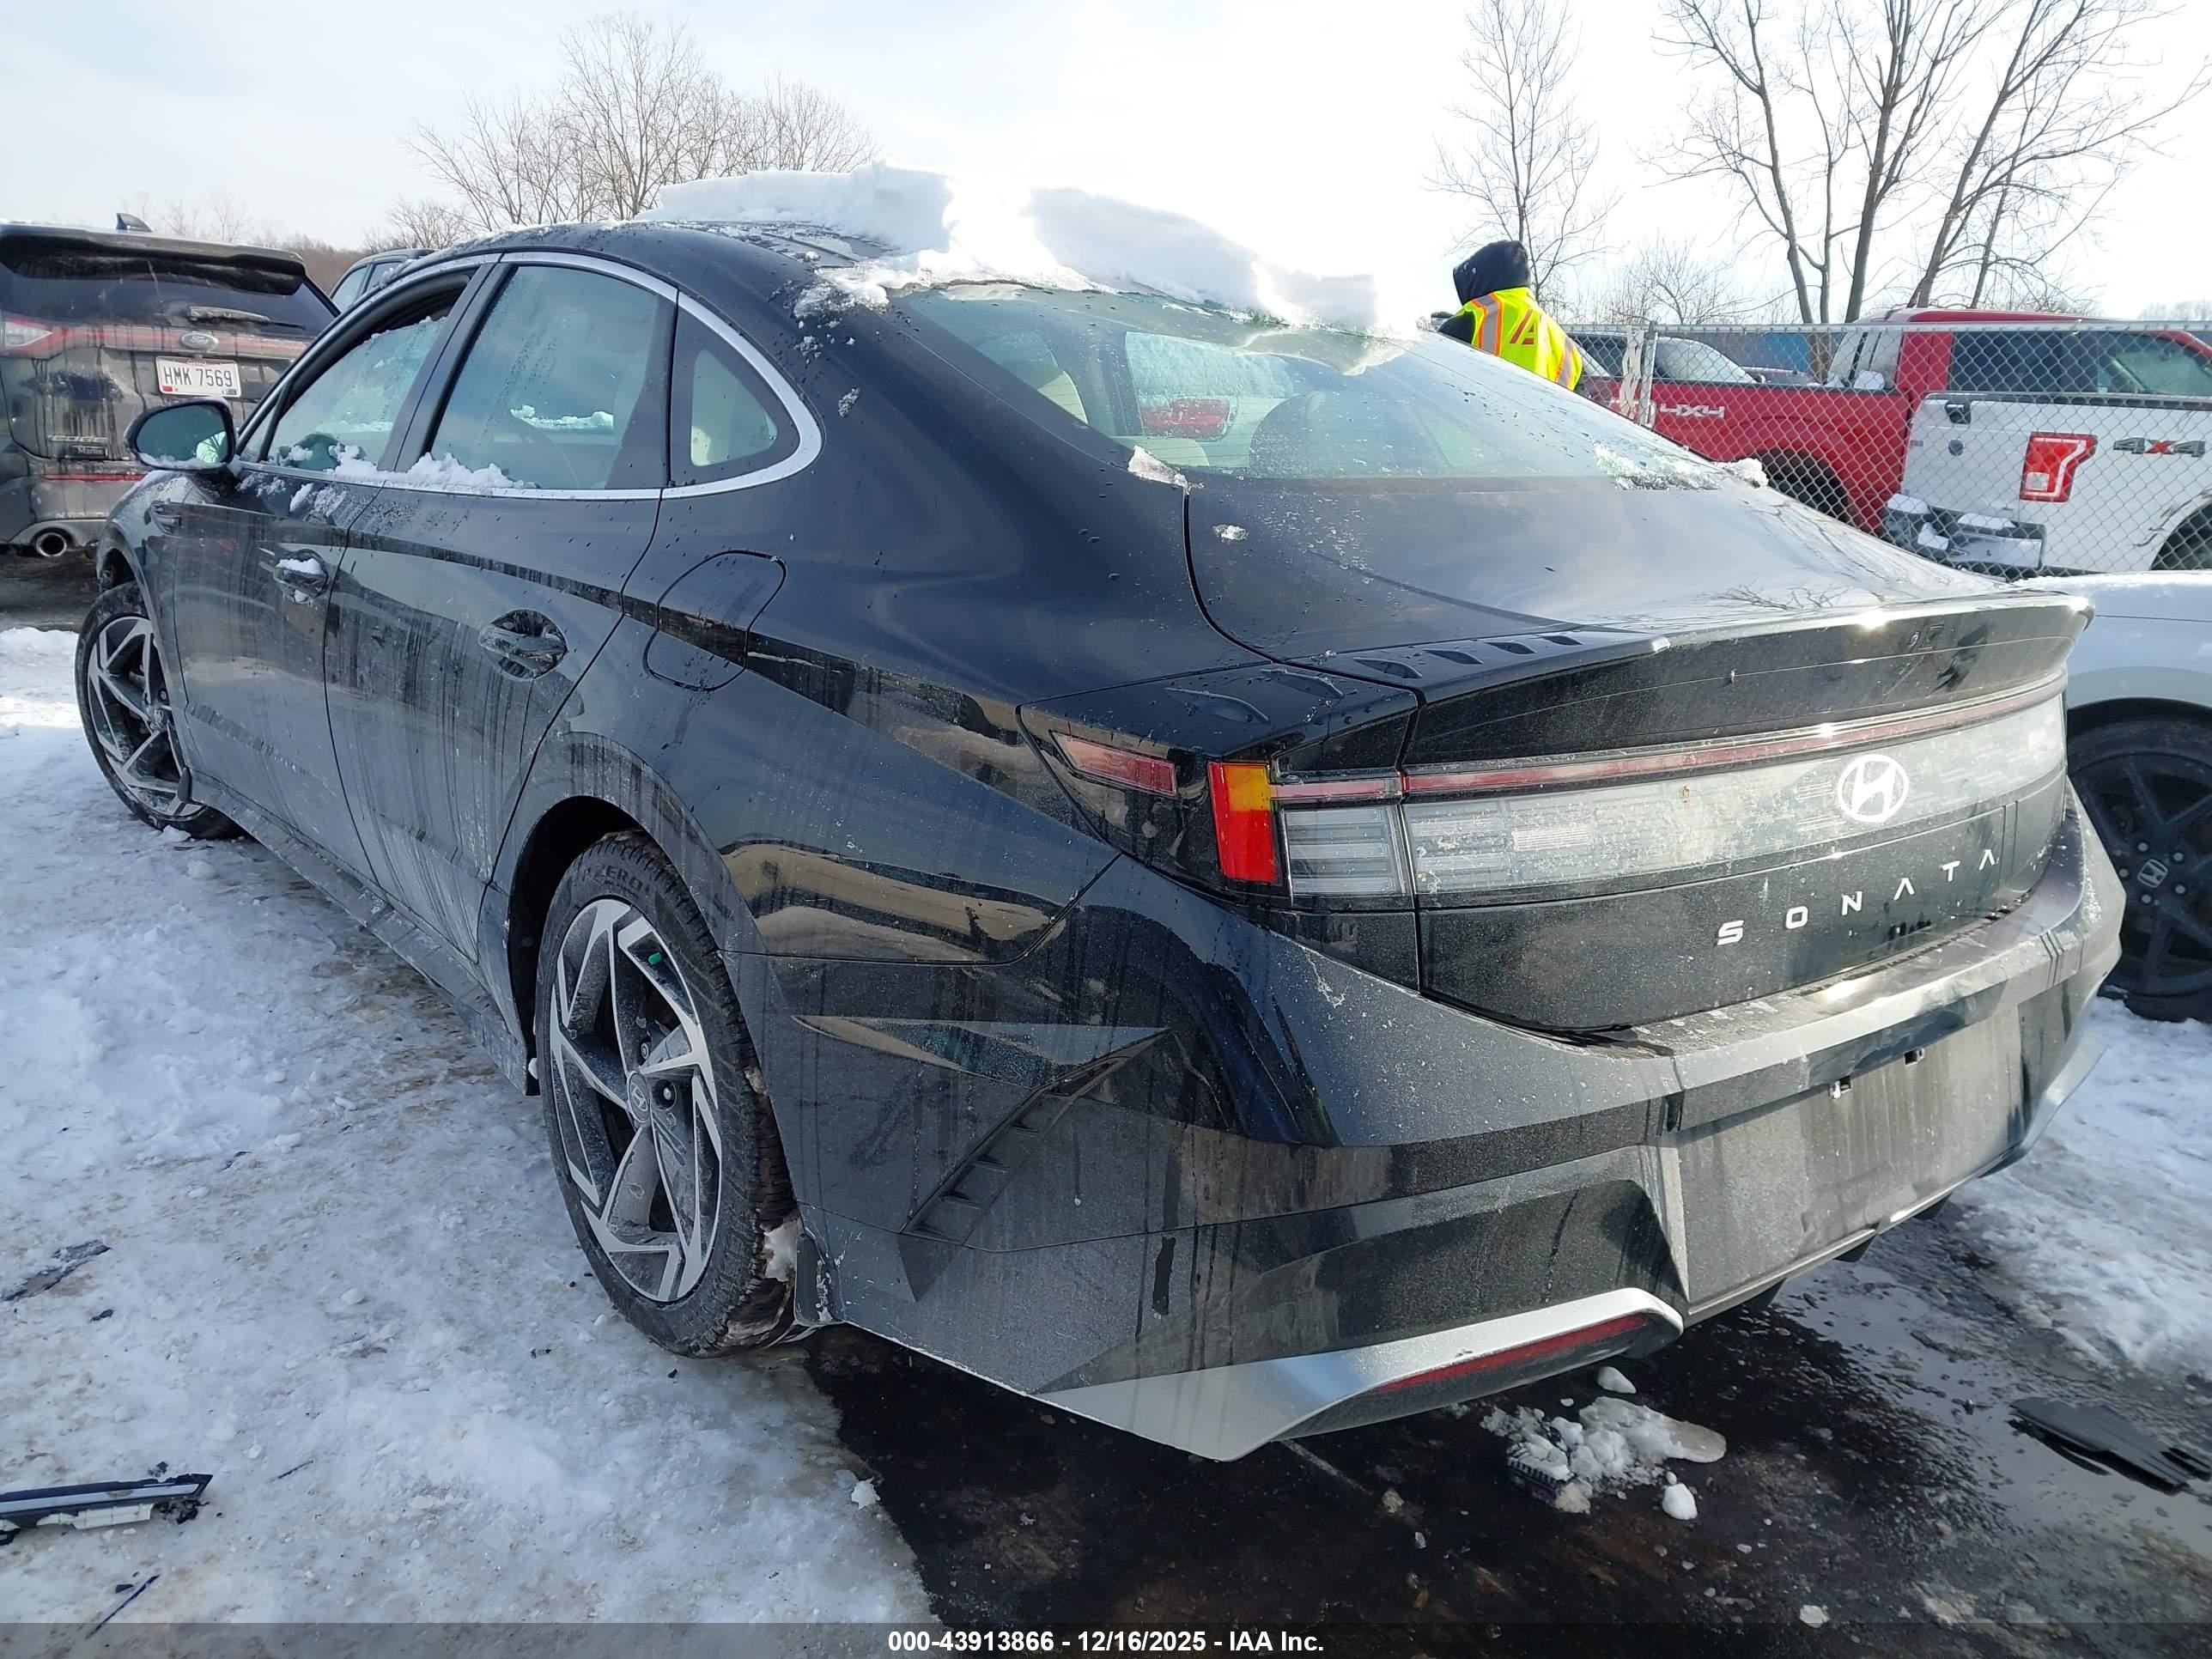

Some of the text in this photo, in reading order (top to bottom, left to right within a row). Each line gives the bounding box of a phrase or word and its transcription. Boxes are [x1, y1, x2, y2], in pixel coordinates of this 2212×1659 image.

[163, 366, 233, 387] HMK 7569
[593, 864, 644, 892] ZERO
[1717, 848, 1996, 946] SONATA
